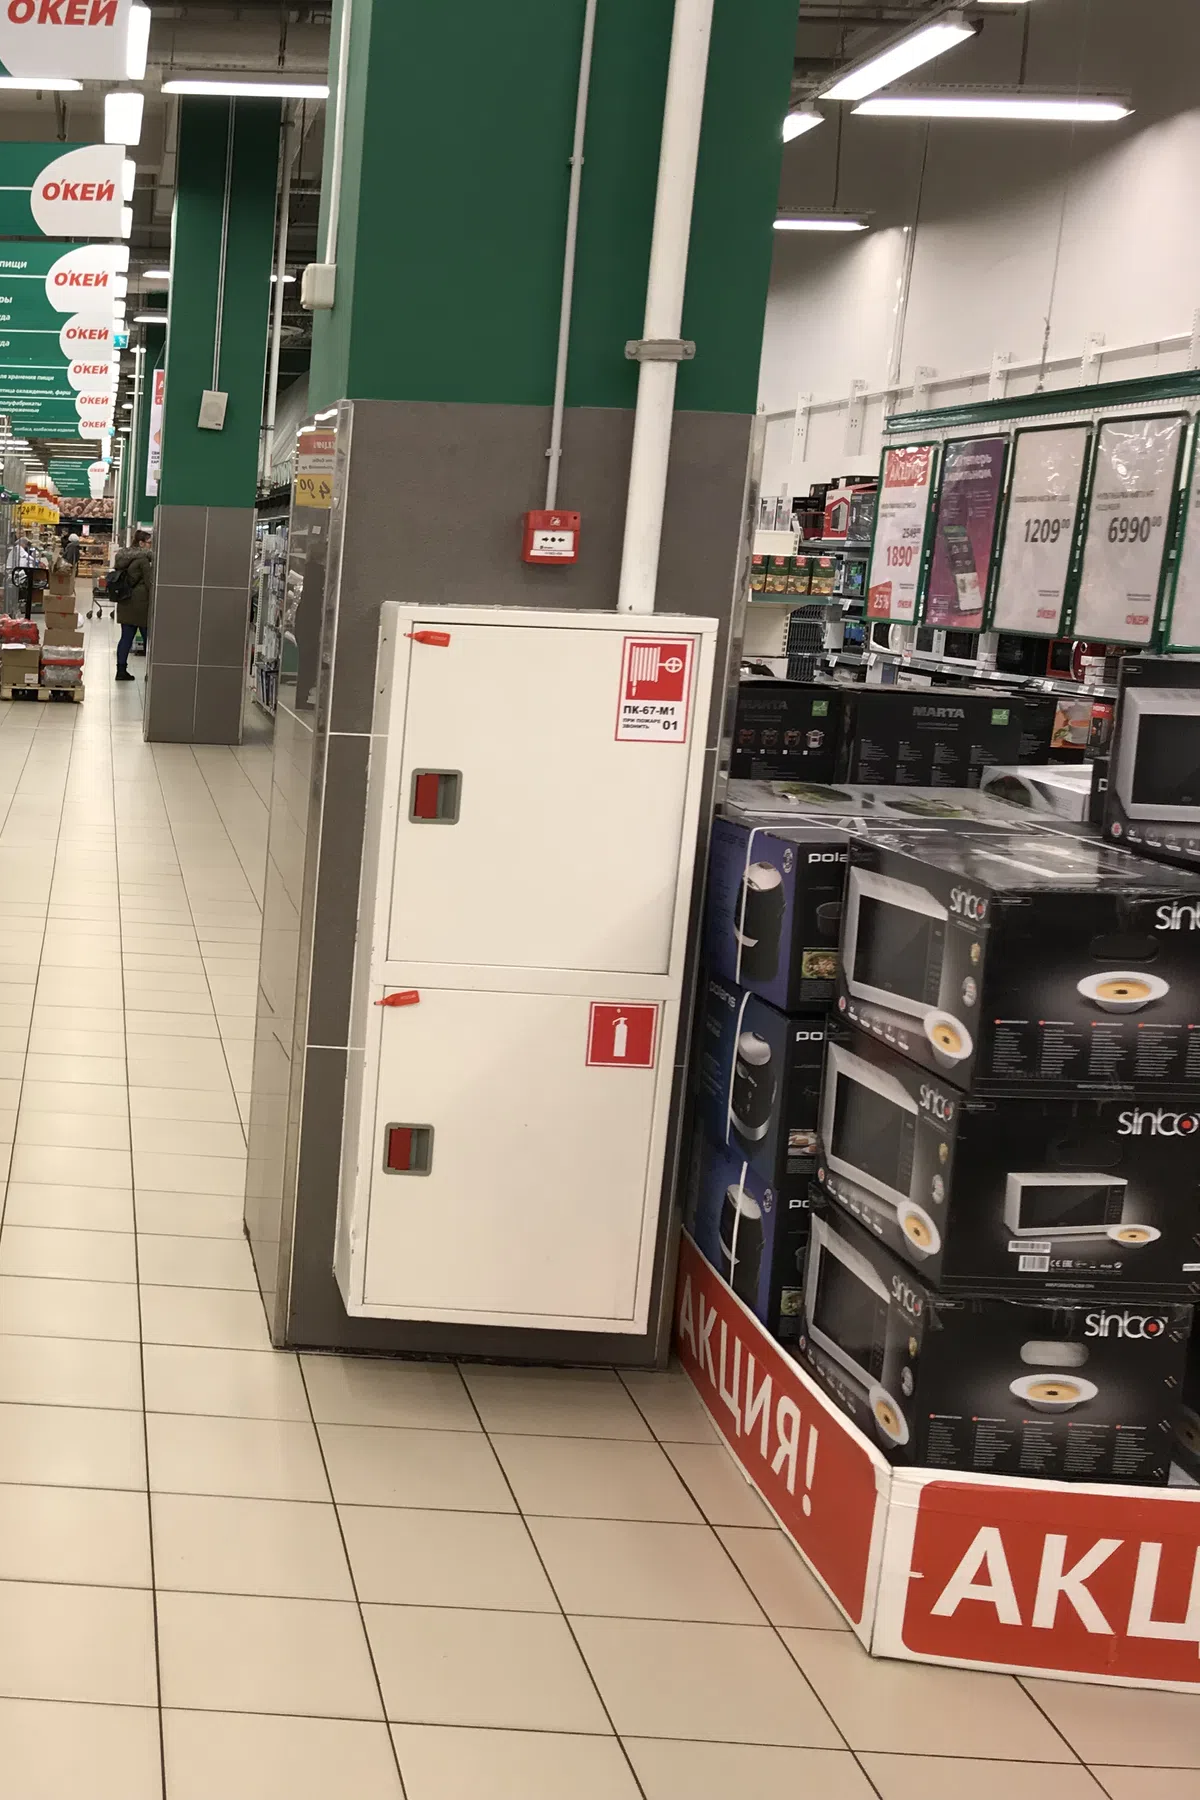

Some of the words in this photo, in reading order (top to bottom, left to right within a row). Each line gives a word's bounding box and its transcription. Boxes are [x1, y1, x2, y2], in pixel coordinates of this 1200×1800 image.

[1023, 518, 1061, 543] 1209
[1107, 516, 1151, 543] 6990
[886, 545, 913, 567] 1890
[623, 705, 675, 715] ПК-67-М1
[912, 706, 966, 719] MARTA
[662, 720, 678, 731] 01
[795, 1031, 824, 1042] po
[1116, 1106, 1200, 1138] sinbo
[1084, 1309, 1169, 1340] sinbo
[678, 1274, 820, 1518] АКЦИЯ!
